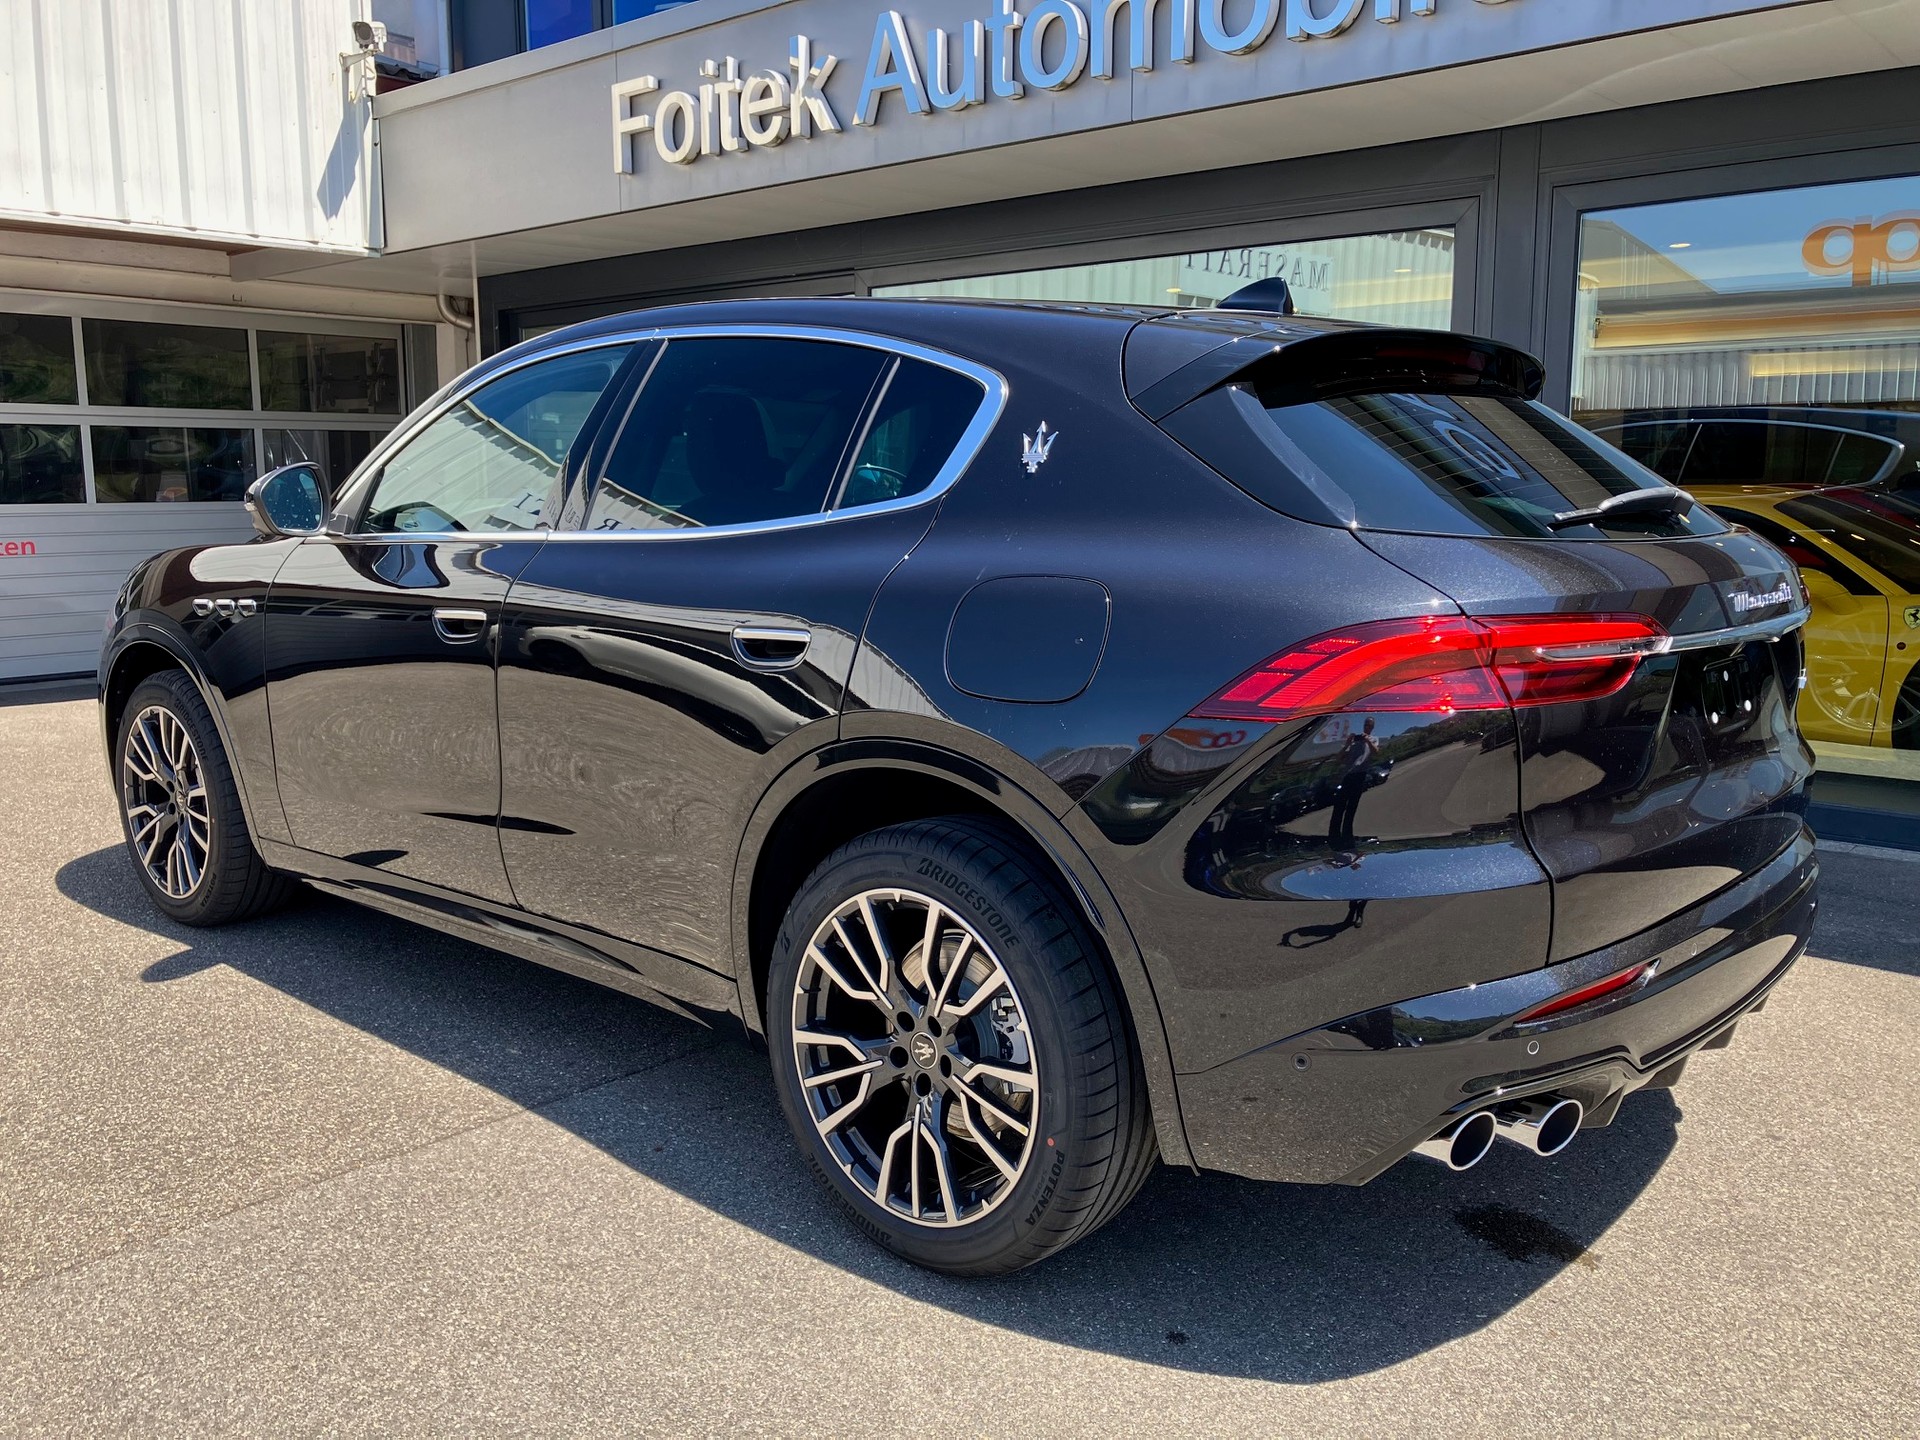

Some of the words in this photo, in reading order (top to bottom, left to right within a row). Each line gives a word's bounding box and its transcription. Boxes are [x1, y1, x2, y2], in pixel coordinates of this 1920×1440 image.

[611, 34, 842, 175] Foitek
[852, 0, 1525, 126] Automo
[917, 858, 1020, 949] BRIDGESTONE
[1025, 1149, 1066, 1226] POTENZA
